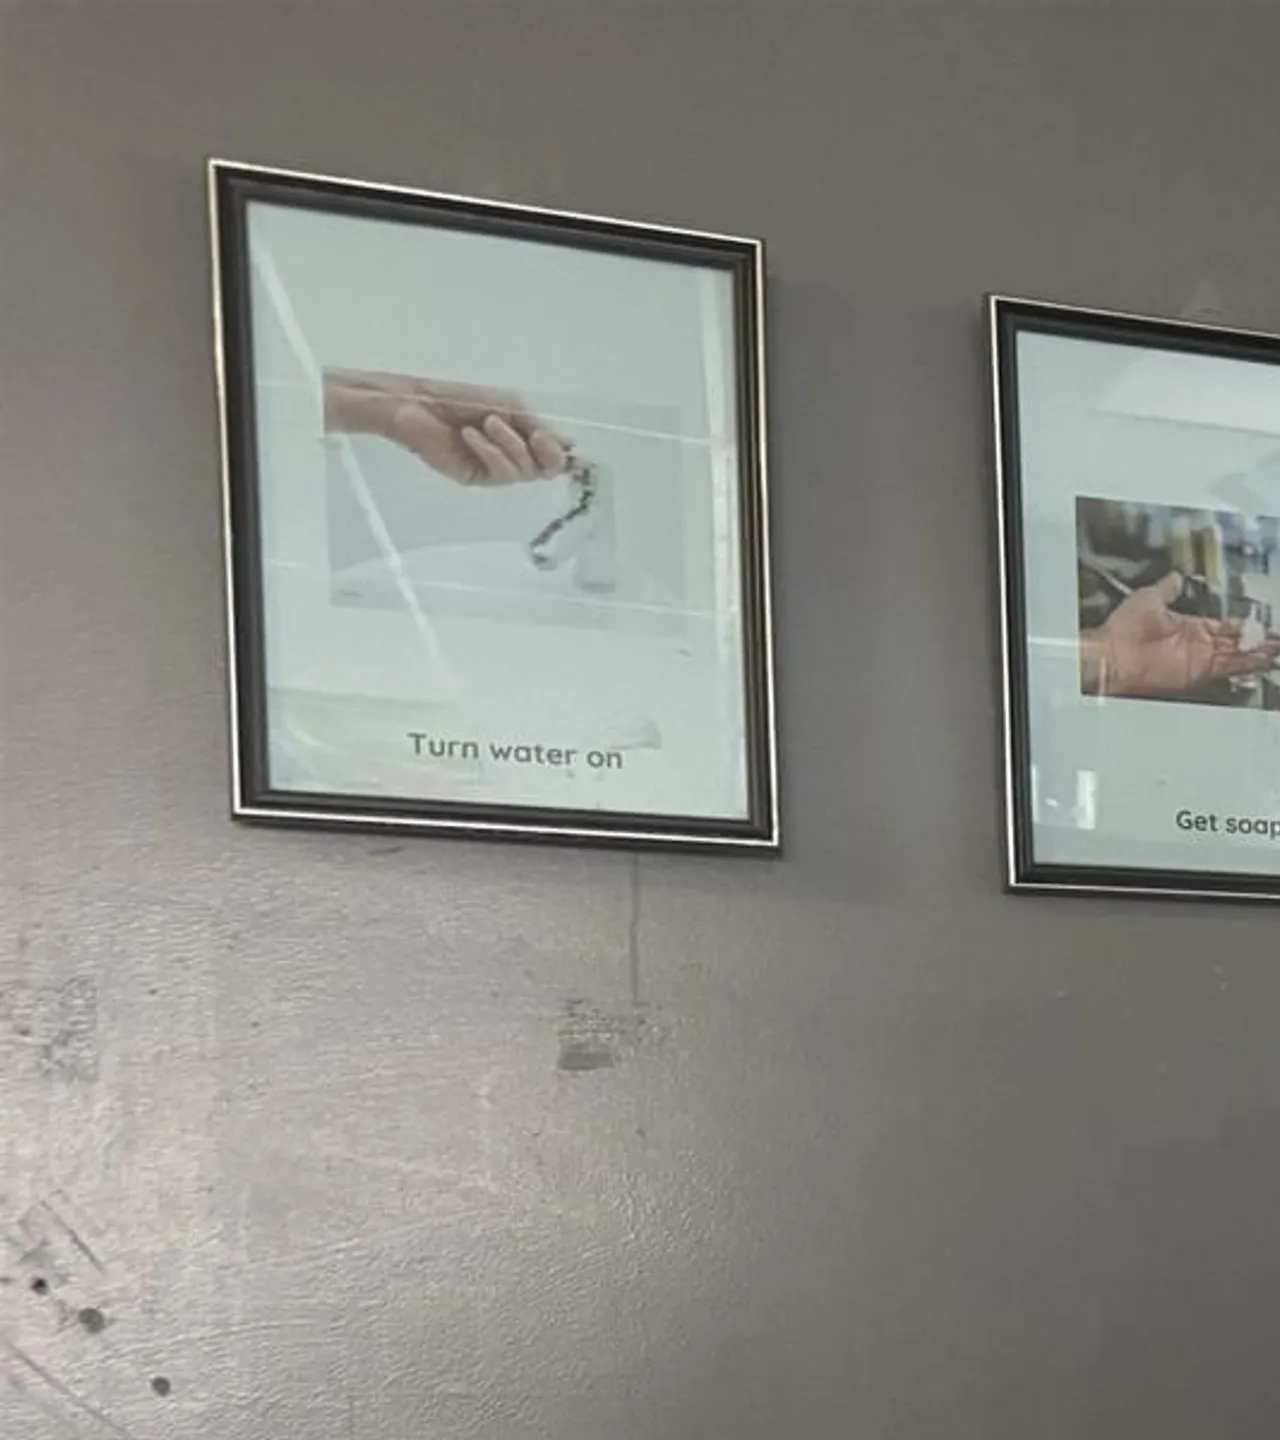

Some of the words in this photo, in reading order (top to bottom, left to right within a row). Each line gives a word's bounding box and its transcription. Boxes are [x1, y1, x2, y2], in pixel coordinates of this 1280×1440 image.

[406, 731, 480, 760] Turn
[489, 741, 577, 767] water
[586, 749, 624, 770] on
[1176, 809, 1218, 832] Get
